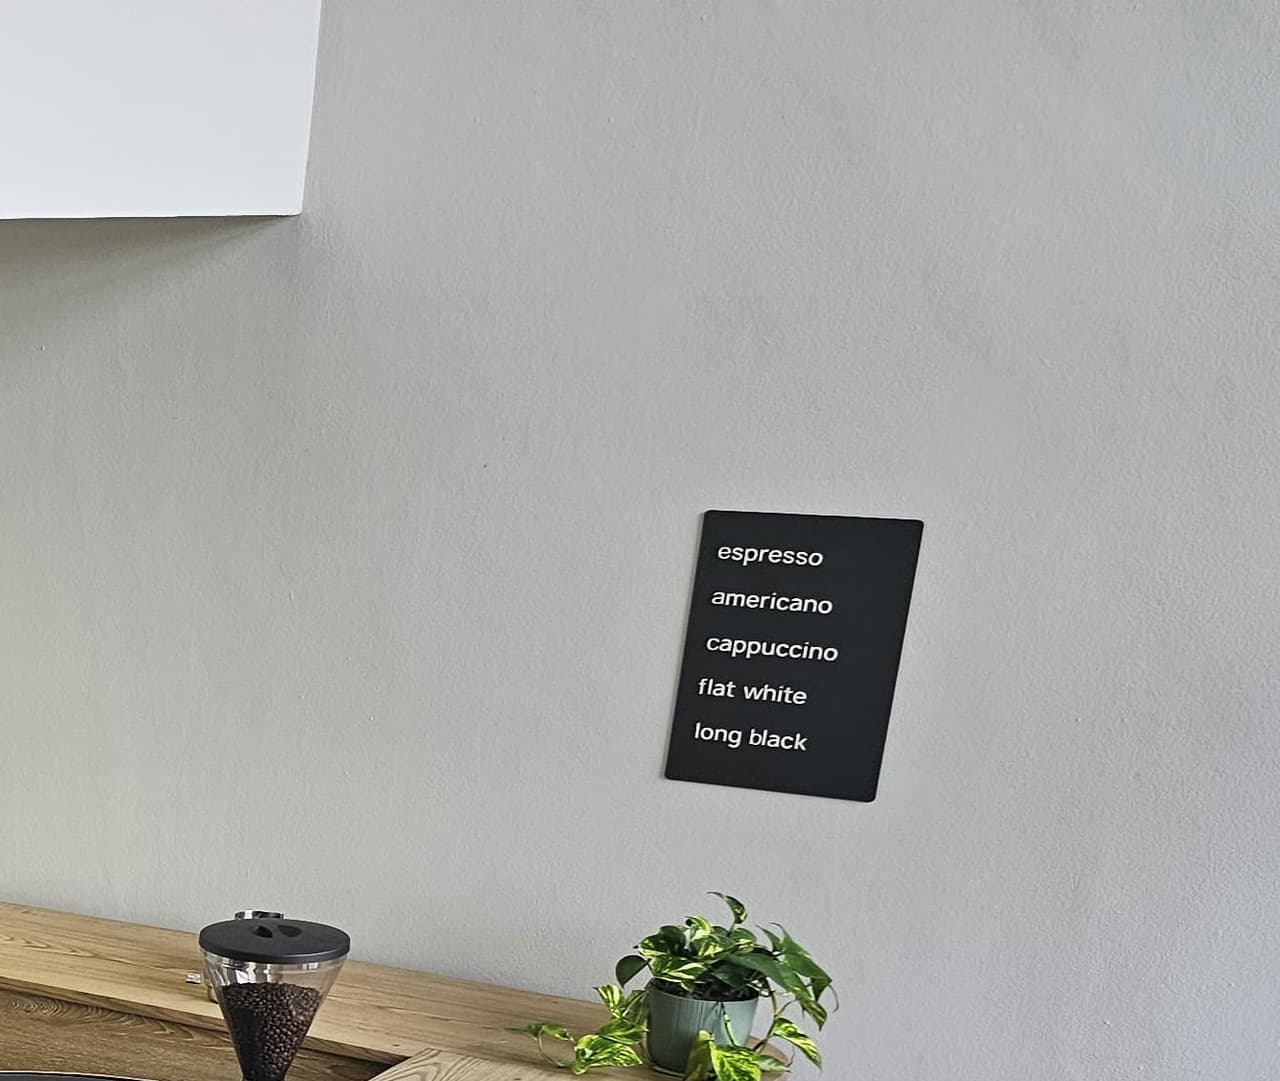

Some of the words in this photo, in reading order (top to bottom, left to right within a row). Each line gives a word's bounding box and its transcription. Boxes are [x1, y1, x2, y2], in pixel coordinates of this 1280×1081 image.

[717, 546, 824, 566] espresso
[711, 591, 833, 614] americano
[706, 637, 839, 661] cappuccino
[698, 678, 736, 698] flat
[743, 685, 808, 705] white
[694, 722, 743, 749] long
[748, 728, 809, 751] black
